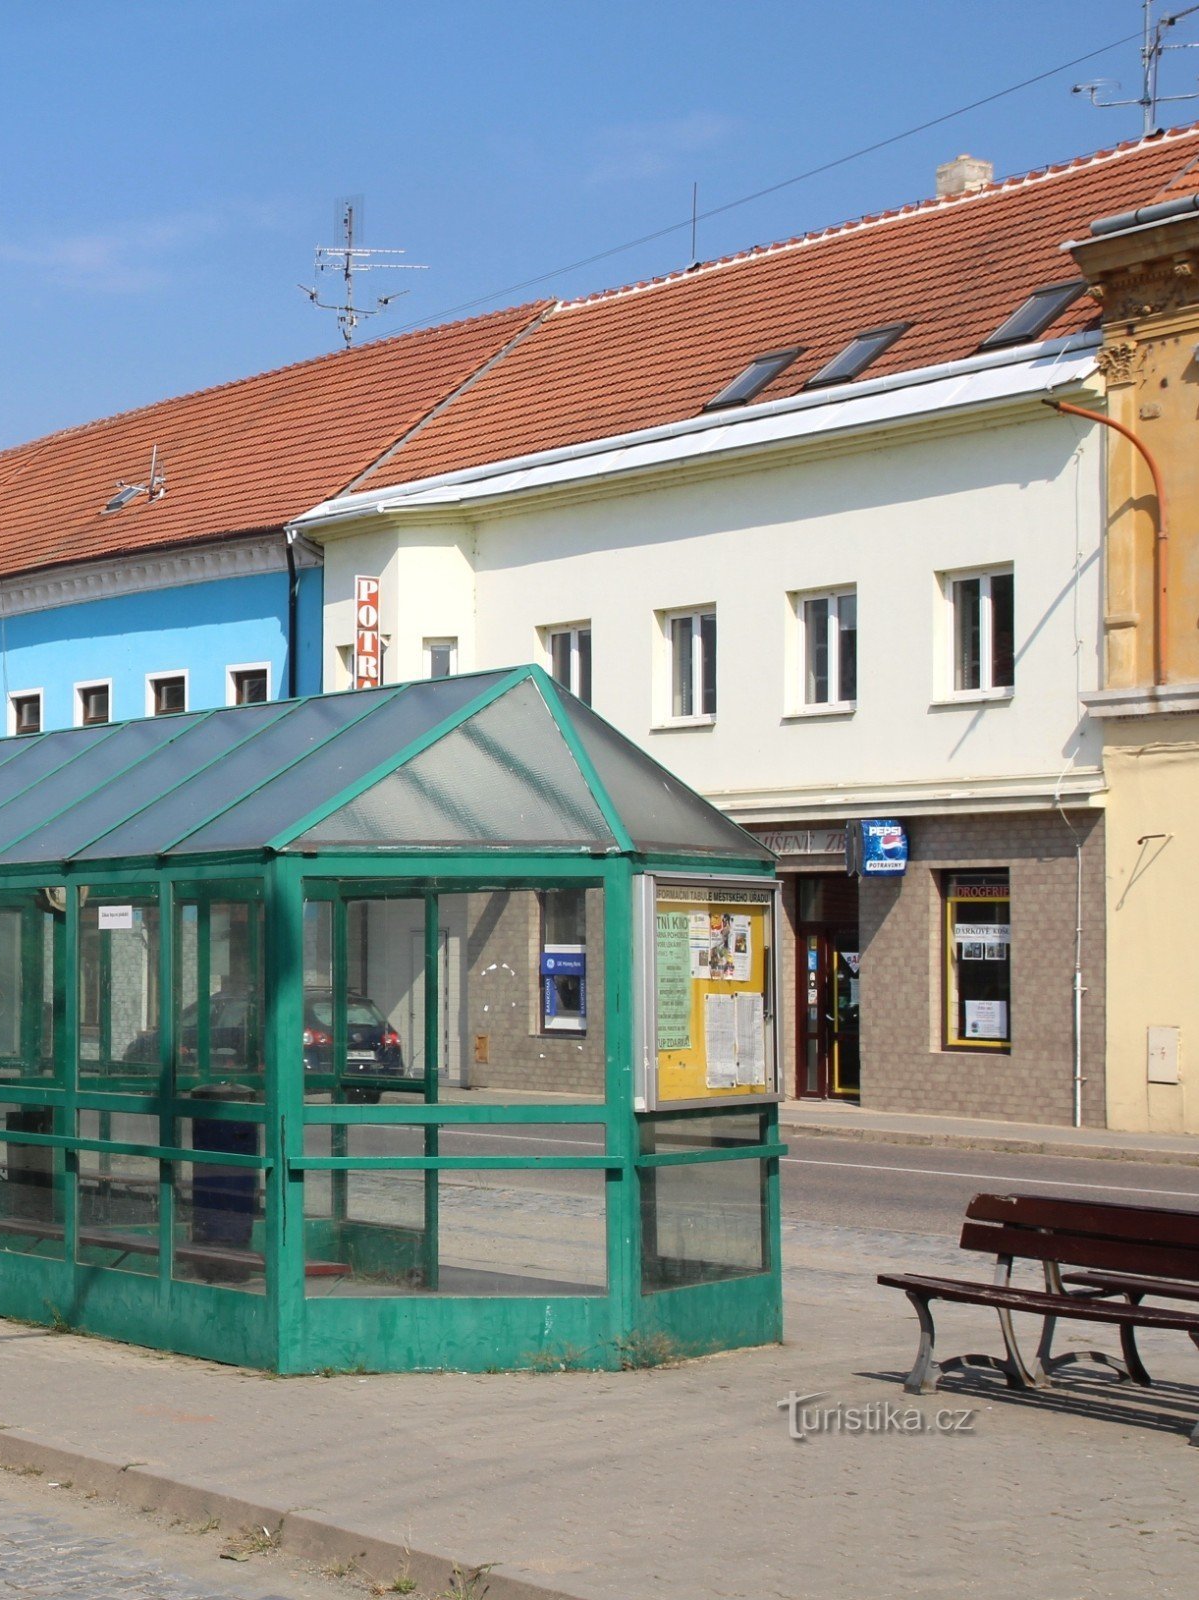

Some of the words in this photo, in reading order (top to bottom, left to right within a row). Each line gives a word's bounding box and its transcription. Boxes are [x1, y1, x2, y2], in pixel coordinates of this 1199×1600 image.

[869, 826, 902, 836] PEPSI
[690, 890, 712, 901] TABULE
[713, 890, 748, 902] MĚSTSKÉHO
[749, 891, 769, 903] ÚŘADU
[957, 886, 1009, 897] DROGERIE
